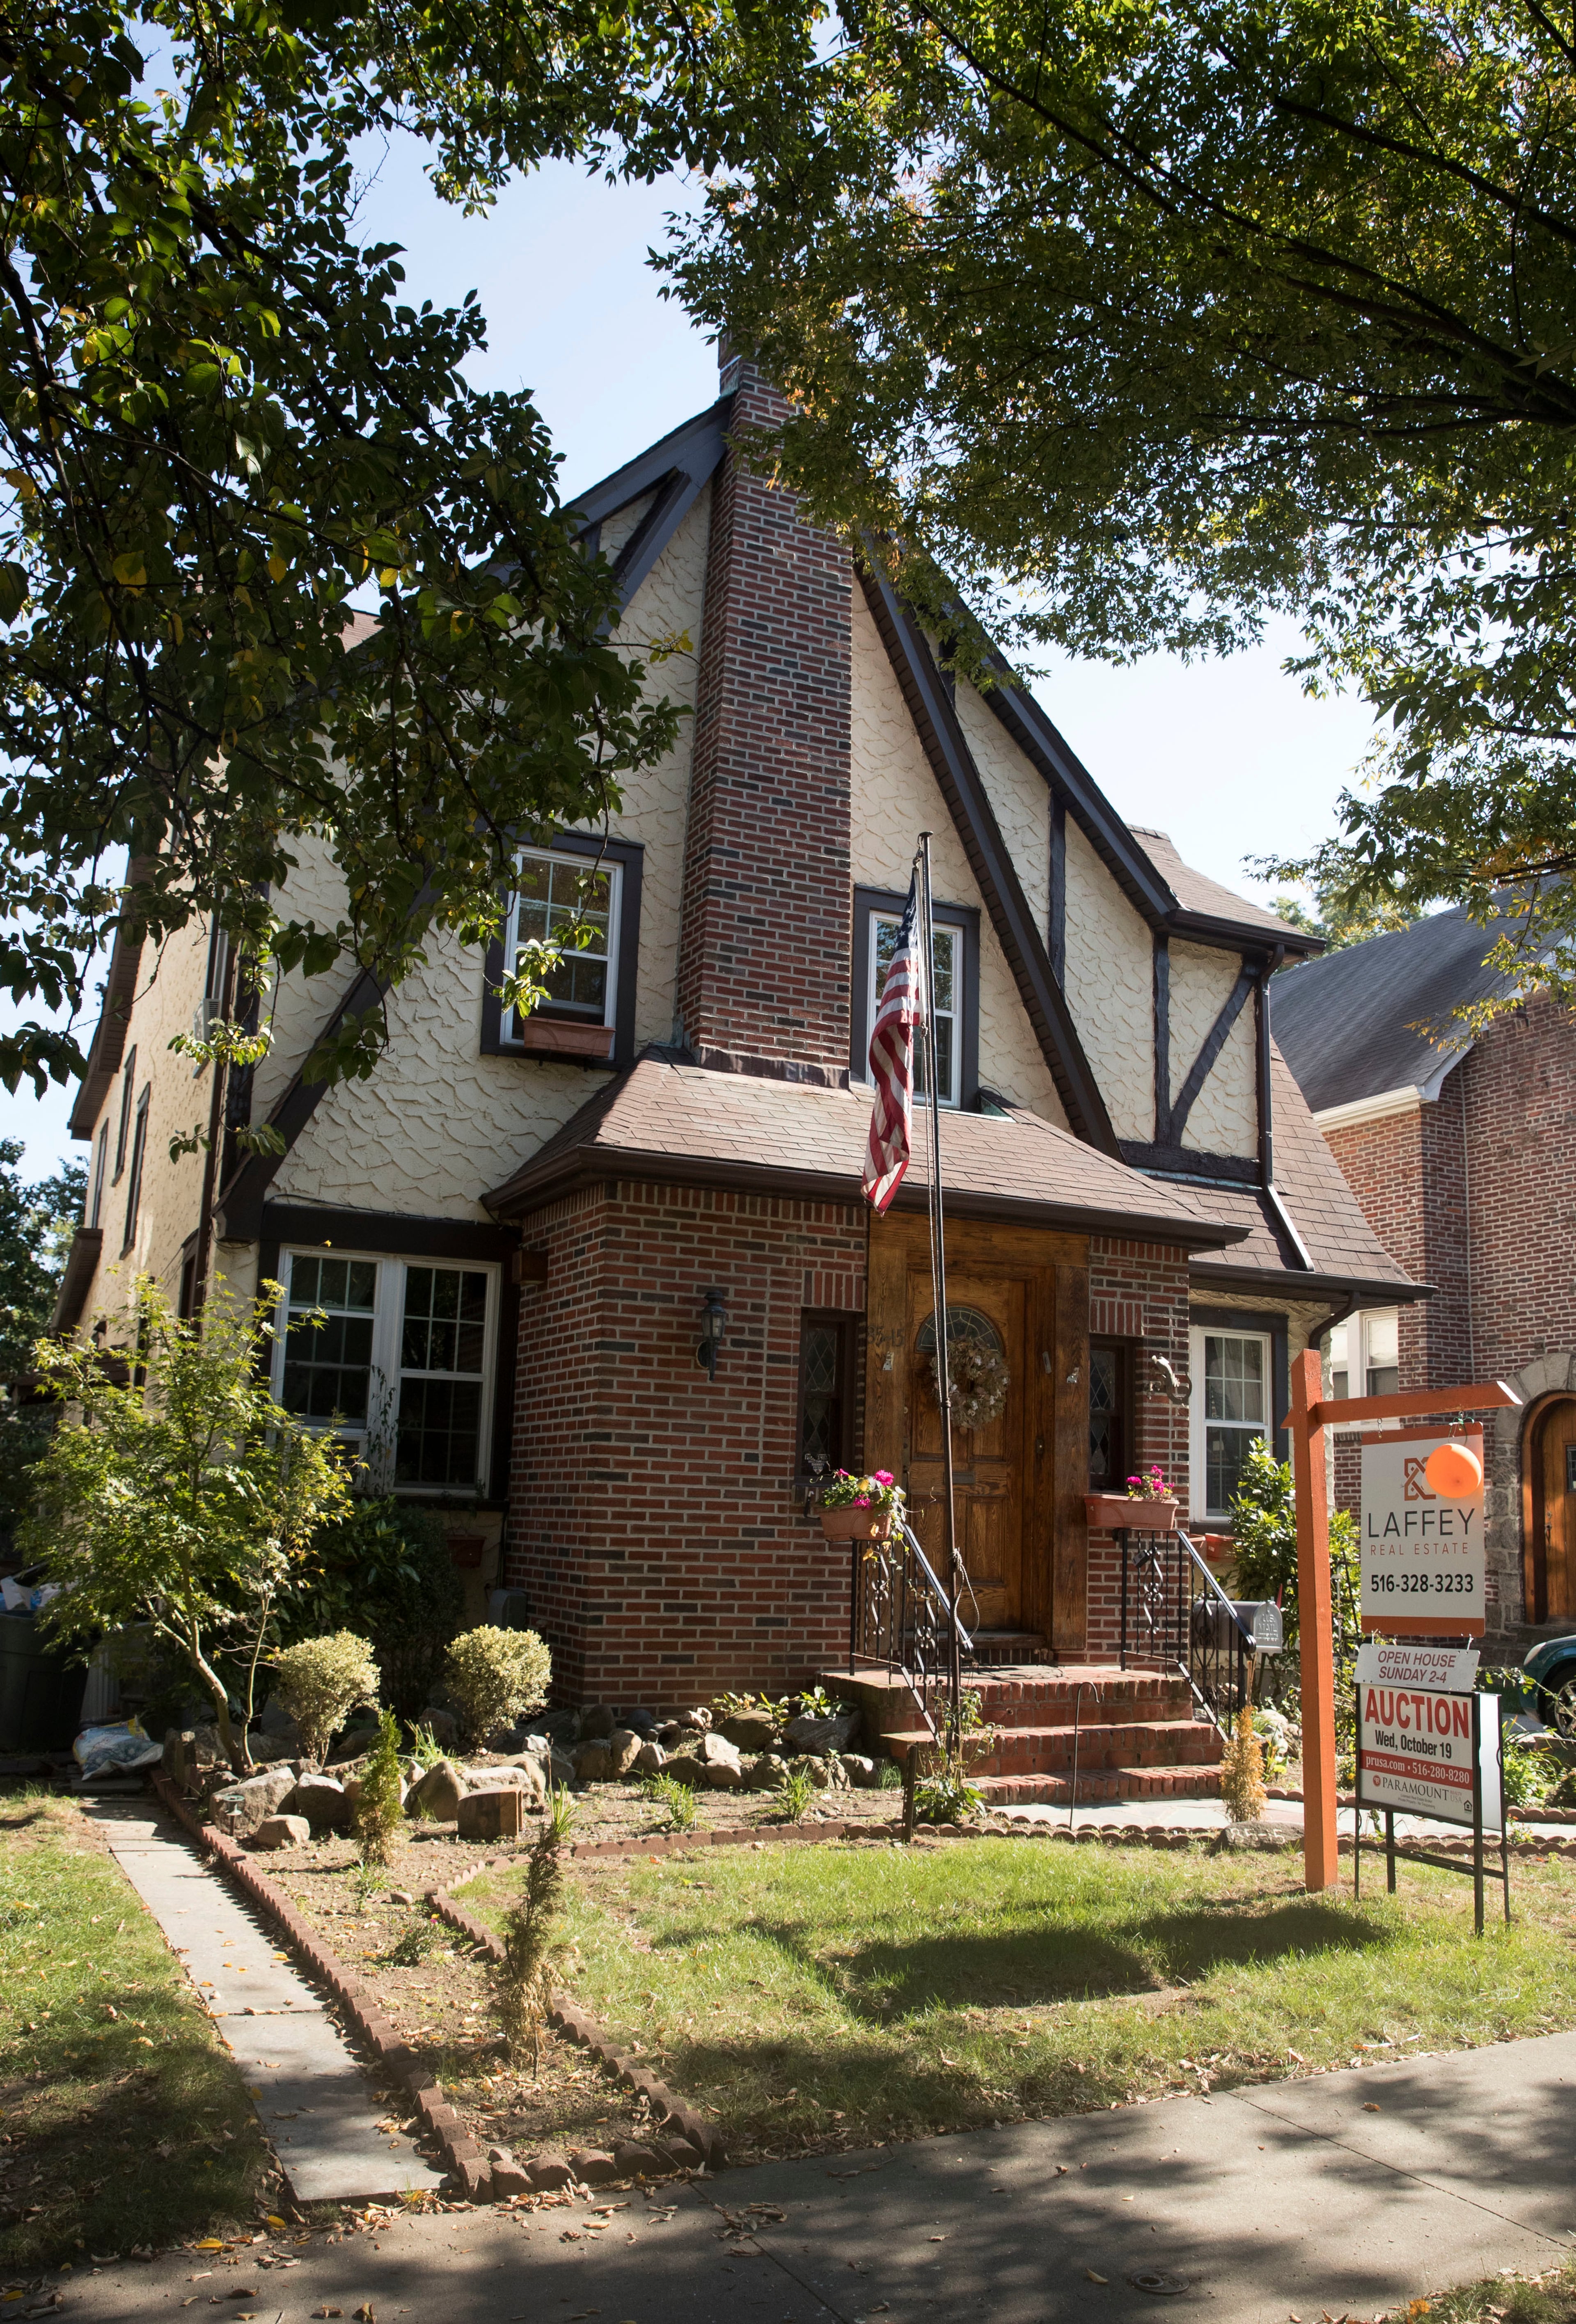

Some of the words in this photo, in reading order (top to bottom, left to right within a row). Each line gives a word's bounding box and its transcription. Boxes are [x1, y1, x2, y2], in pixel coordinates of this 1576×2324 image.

[1368, 1508, 1475, 1537] LAFFEY
[1370, 1544, 1404, 1555] REAL
[1414, 1542, 1468, 1555] ESTATE
[1371, 1574, 1473, 1592] 516-328-3233
[1378, 1650, 1411, 1665] OPEN
[1413, 1653, 1456, 1668] HOUSE
[1379, 1666, 1427, 1681] SUNDAY
[1429, 1671, 1447, 1683] 2-4
[1365, 1689, 1469, 1739] AUCTION
[1375, 1729, 1397, 1751] Wed,
[1401, 1734, 1437, 1756] October
[1440, 1742, 1452, 1759] 19
[1366, 1755, 1405, 1772] prusa.com
[1412, 1762, 1470, 1784] 516-280-8280
[1382, 1777, 1449, 1800] PARAMOUNT
[1450, 1795, 1462, 1803] USA
